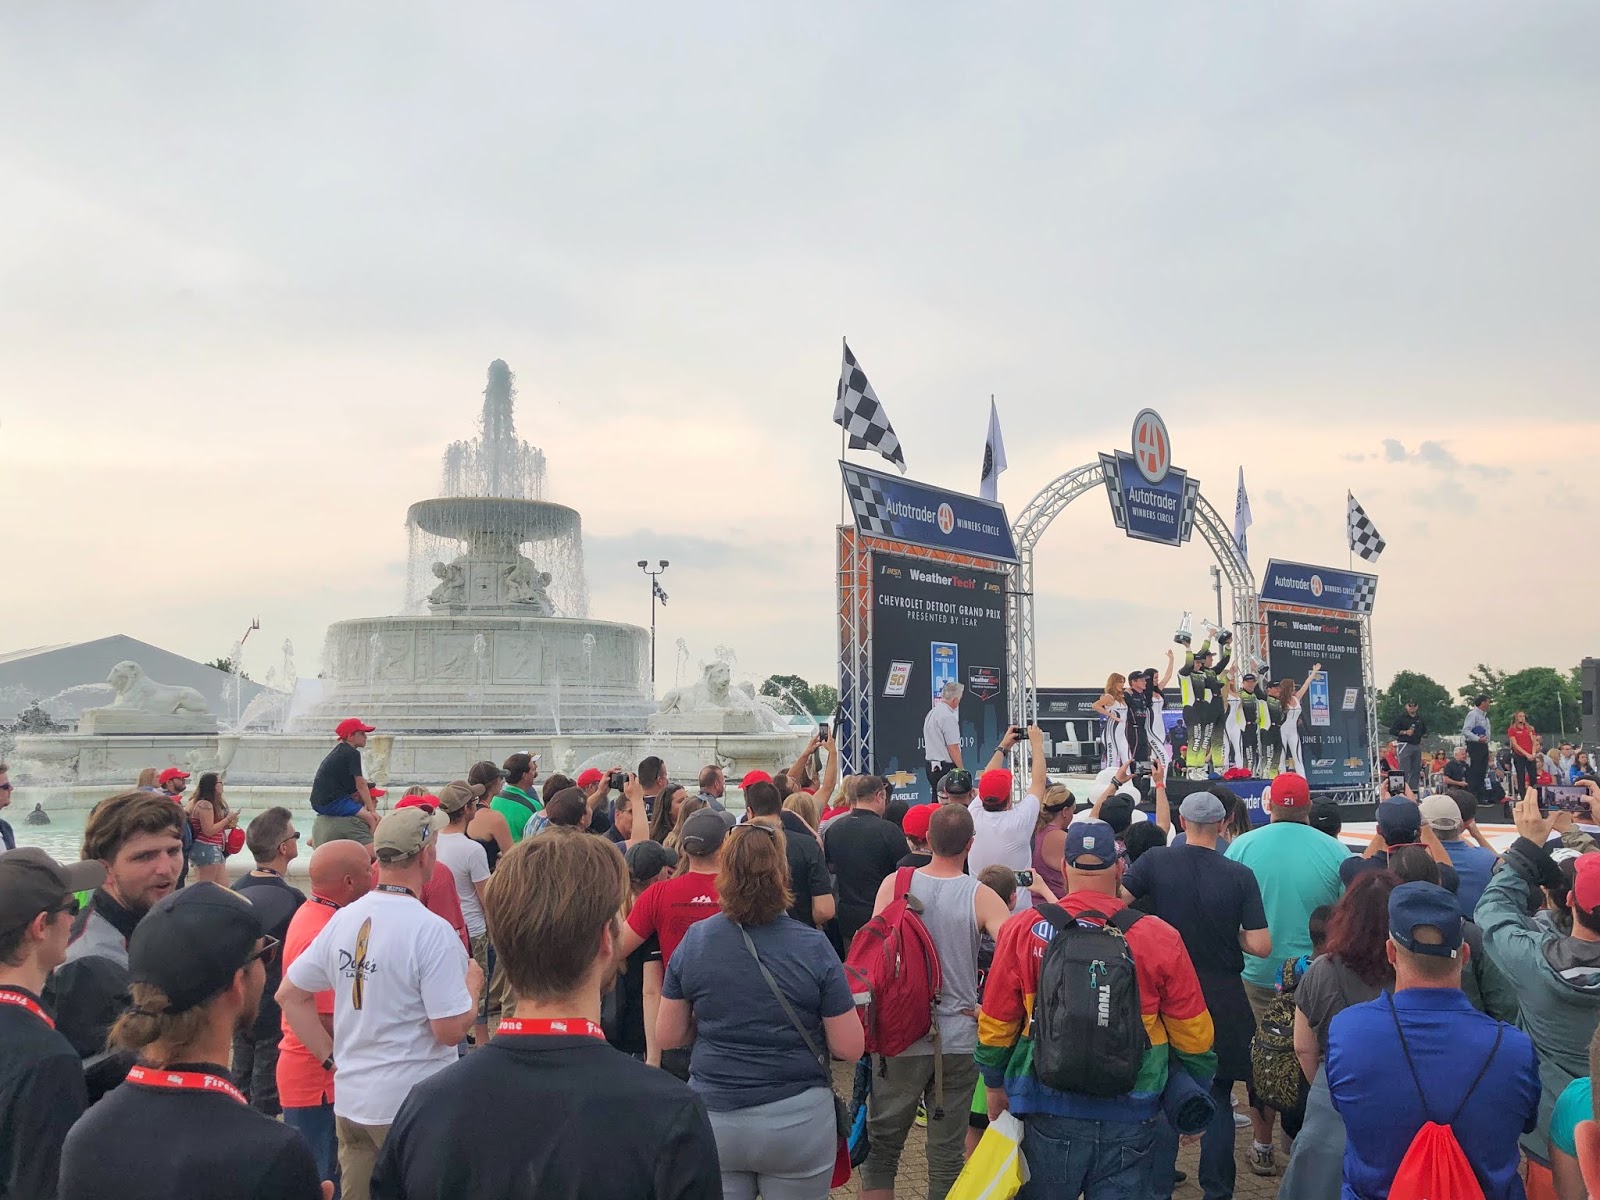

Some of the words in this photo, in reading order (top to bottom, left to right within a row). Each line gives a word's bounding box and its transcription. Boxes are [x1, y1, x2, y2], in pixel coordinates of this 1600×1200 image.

[1129, 486, 1177, 511] Autotrader
[886, 498, 936, 524] Autotrader
[957, 518, 981, 532] WINNERS
[982, 524, 1000, 536] CIRCLE
[1132, 506, 1156, 520] WINNERS
[1157, 512, 1174, 524] CIRCLE
[910, 569, 976, 589] WeatherTech
[1275, 575, 1310, 590] Autotrader
[879, 594, 923, 609] CHEVROLET
[926, 601, 956, 614] DETROIT
[959, 605, 983, 617] GRAND
[986, 609, 1001, 620] PRIX
[907, 610, 947, 624] PRESENTED
[951, 616, 958, 624] BY
[962, 618, 978, 627] LEAR
[1273, 640, 1303, 649] CHEVROLET
[1304, 643, 1326, 651] DETROIT
[1327, 644, 1345, 653] GRAND
[1291, 650, 1320, 658] PRESENTED
[889, 674, 905, 685] 50
[917, 737, 926, 749] JU
[960, 737, 975, 748] 019
[1302, 735, 1317, 744] JUNE
[1319, 736, 1325, 744] 1,
[1327, 735, 1342, 744] 2019
[890, 792, 918, 801] EVROLET
[1097, 984, 1111, 1028] THULE
